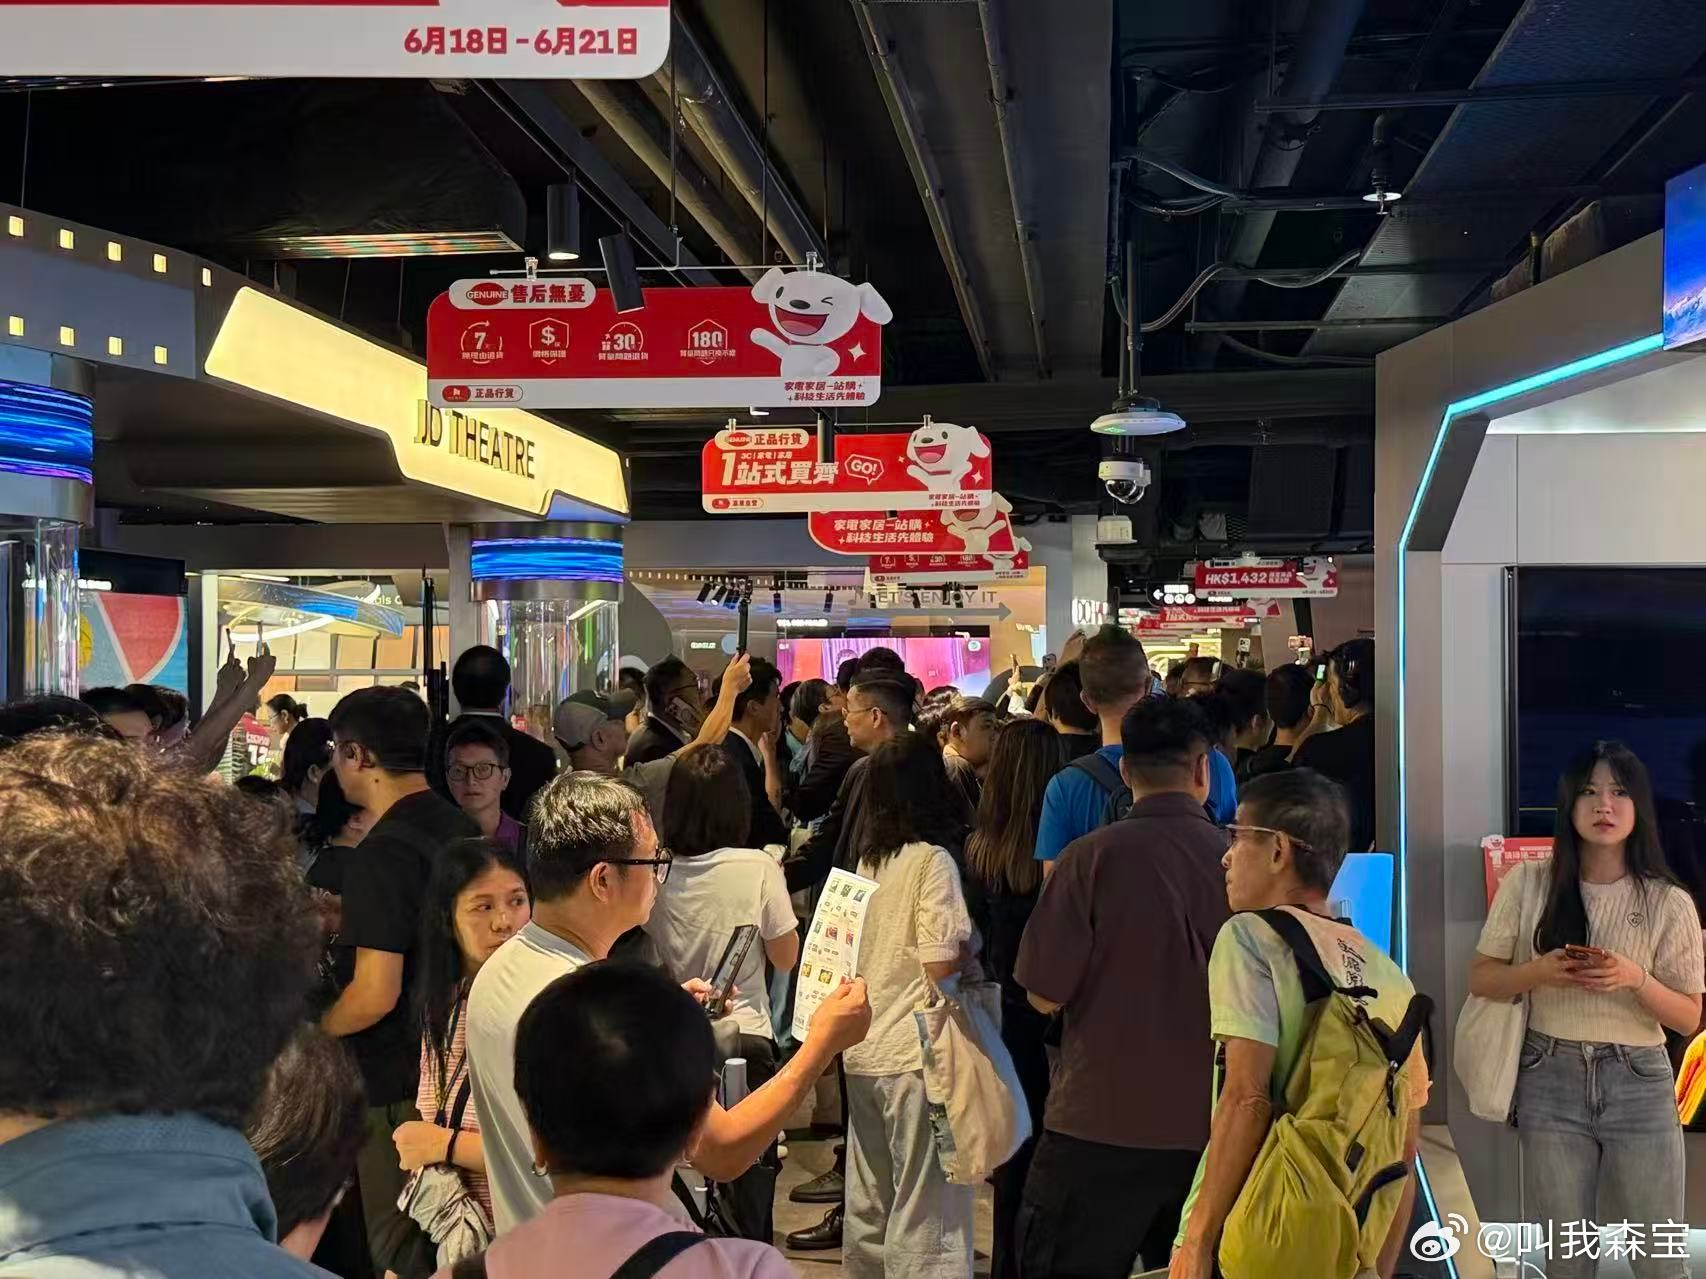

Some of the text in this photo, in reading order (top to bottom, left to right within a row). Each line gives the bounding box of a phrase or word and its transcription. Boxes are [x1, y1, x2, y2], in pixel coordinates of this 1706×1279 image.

[466, 290, 508, 300] GENUINE
[511, 284, 586, 303] 售后無憂
[784, 381, 856, 391] 家電家居一站購
[475, 388, 514, 399] 正品行貨
[794, 392, 865, 401] 科技生活先體驗
[416, 400, 535, 479] JD THEATRE
[754, 432, 802, 446] 正品行貨
[850, 459, 878, 476] GO!
[834, 519, 922, 531] 家電家居一站購
[846, 532, 934, 543] 科技生活先體驗
[1205, 571, 1268, 585] HK$1,432
[982, 591, 997, 602] IT
